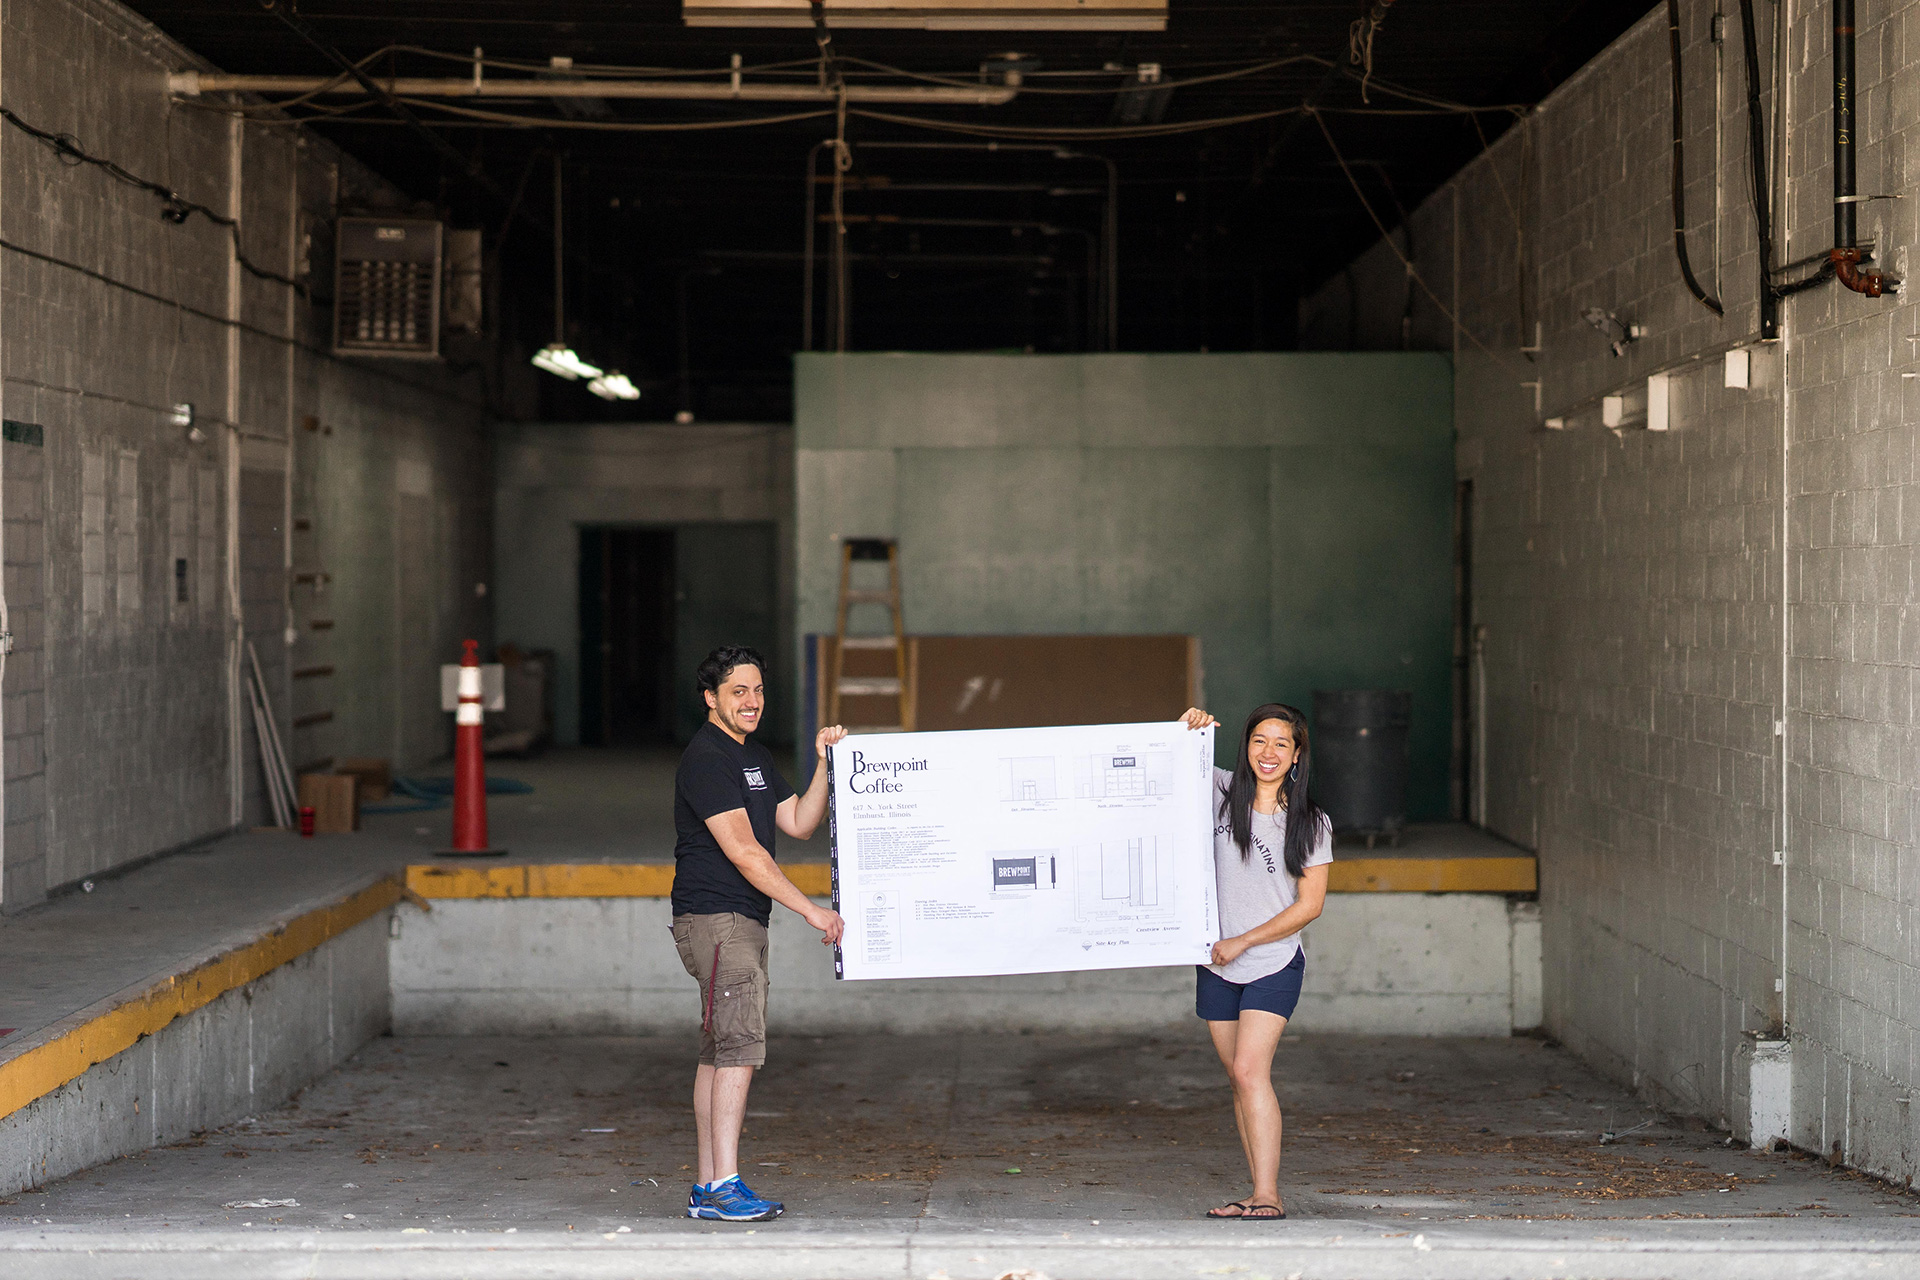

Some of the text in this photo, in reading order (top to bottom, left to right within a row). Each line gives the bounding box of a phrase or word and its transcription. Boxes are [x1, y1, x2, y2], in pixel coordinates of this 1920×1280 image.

[851, 751, 929, 778] Brewpoint
[849, 771, 904, 794] Coffee
[896, 802, 918, 810] Street
